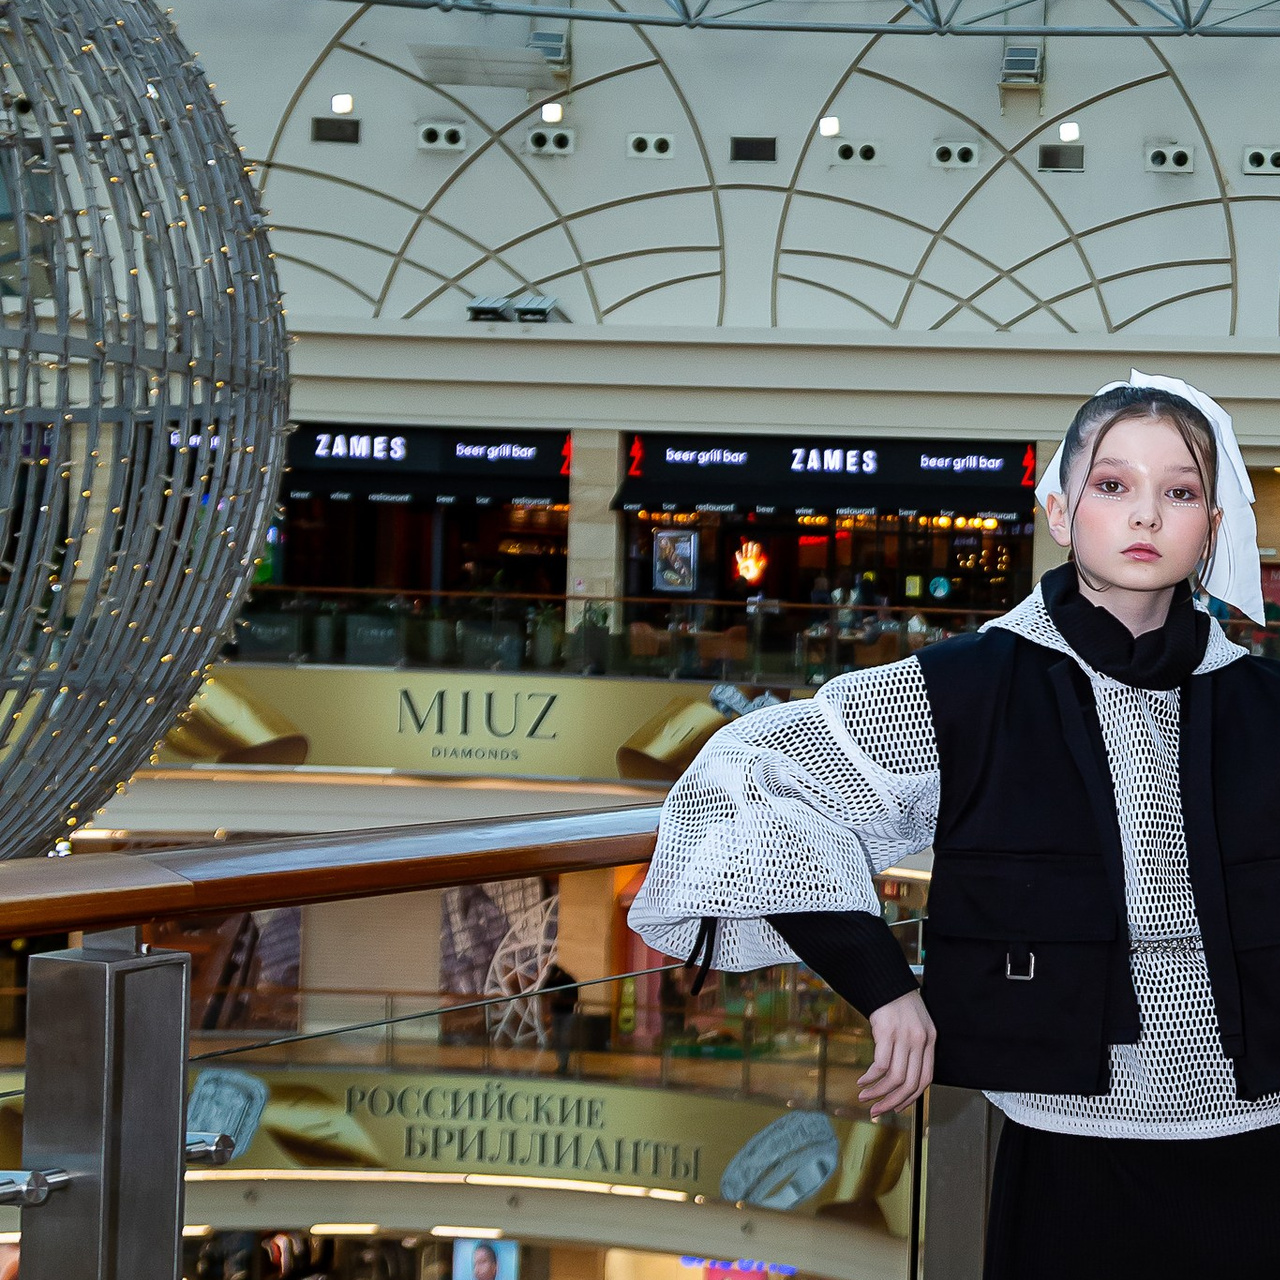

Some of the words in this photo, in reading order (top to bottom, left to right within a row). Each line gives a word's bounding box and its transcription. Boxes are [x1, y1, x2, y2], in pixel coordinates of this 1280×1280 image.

[315, 433, 407, 460] ZAMES
[456, 442, 486, 458] beer
[487, 443, 511, 461] grill
[511, 444, 536, 459] bar
[665, 447, 697, 463] beer
[697, 448, 722, 466] grill
[722, 449, 748, 464] bar
[791, 448, 878, 474] ZAMES
[920, 454, 952, 470] beer
[952, 455, 978, 473] grill
[978, 456, 1004, 471] bar
[397, 687, 559, 740] MIUZ
[431, 746, 520, 761] DIAMONDS
[345, 1082, 606, 1129] РОССИЙСКИЕ
[404, 1123, 702, 1182] БРИЛЛИАНТЫ
